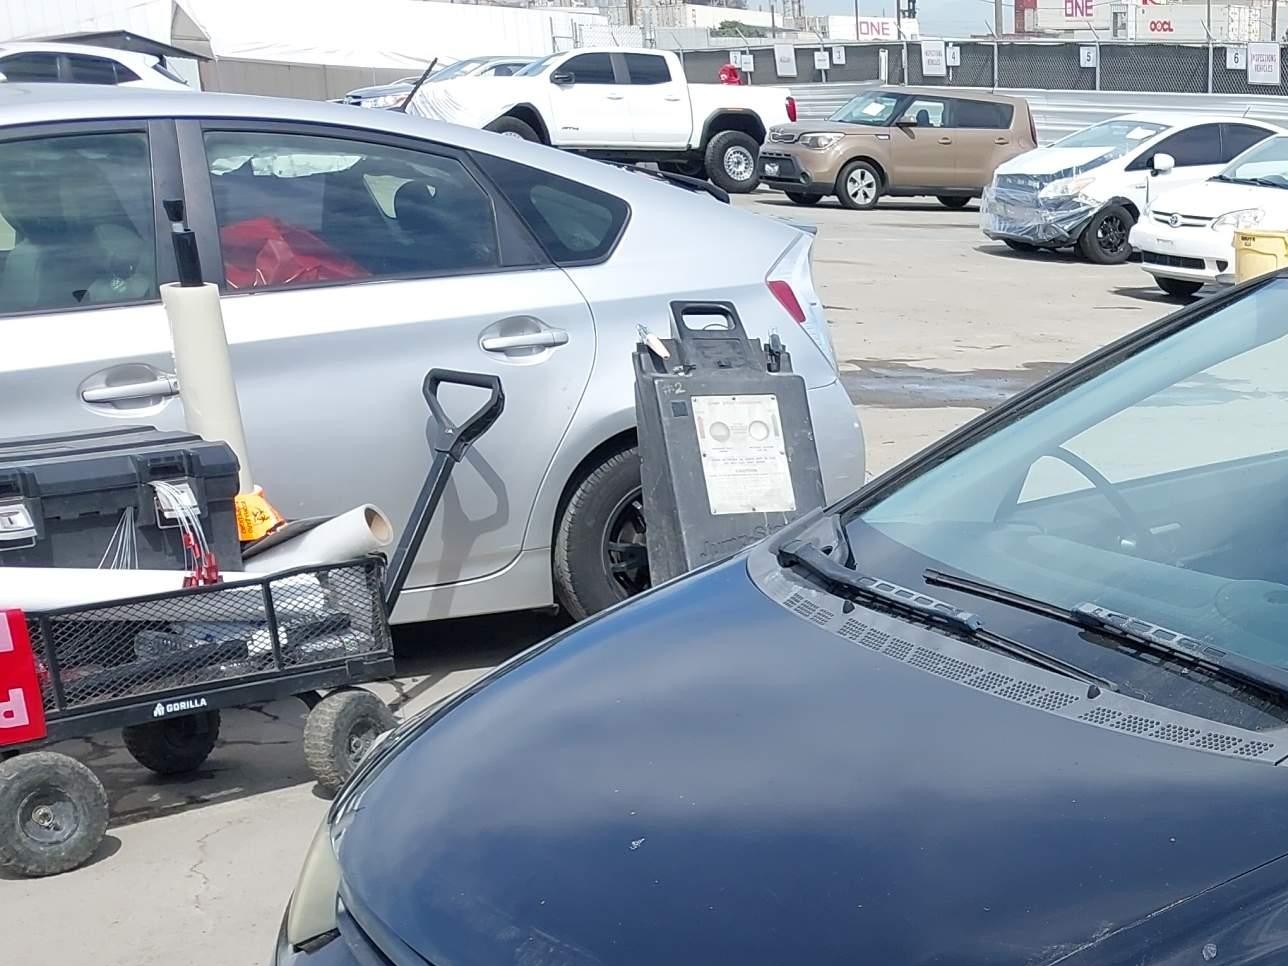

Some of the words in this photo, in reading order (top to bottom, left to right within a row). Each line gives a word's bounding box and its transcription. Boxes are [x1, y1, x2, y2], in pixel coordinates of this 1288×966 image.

[1065, 0, 1093, 17] ONE
[860, 21, 890, 35] ONE
[1150, 20, 1174, 32] OOCL
[1086, 51, 1092, 62] 5
[1233, 52, 1239, 64] 6
[166, 698, 208, 713] GORILLA
